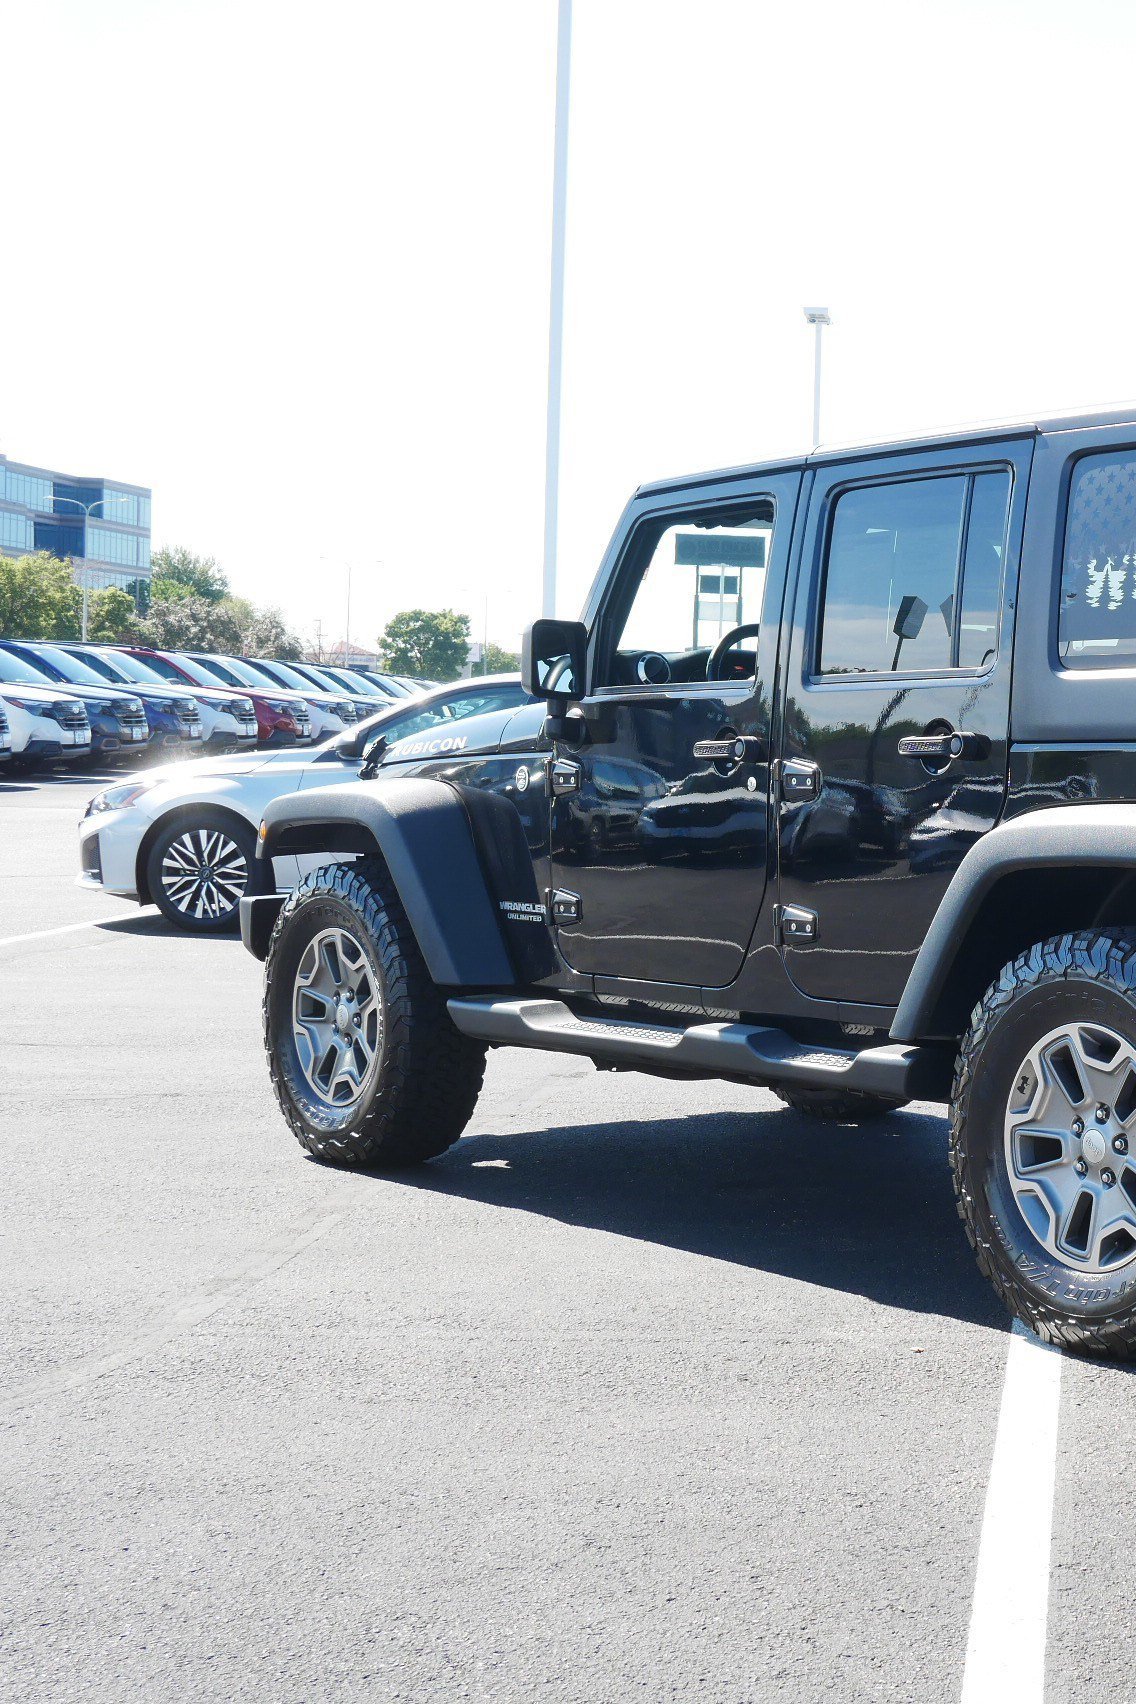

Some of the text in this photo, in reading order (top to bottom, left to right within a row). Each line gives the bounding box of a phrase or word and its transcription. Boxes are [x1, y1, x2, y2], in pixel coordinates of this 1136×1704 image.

[394, 736, 468, 758] RUBICON
[499, 901, 547, 914] WRANGLER
[507, 912, 542, 922] UNLIMITED
